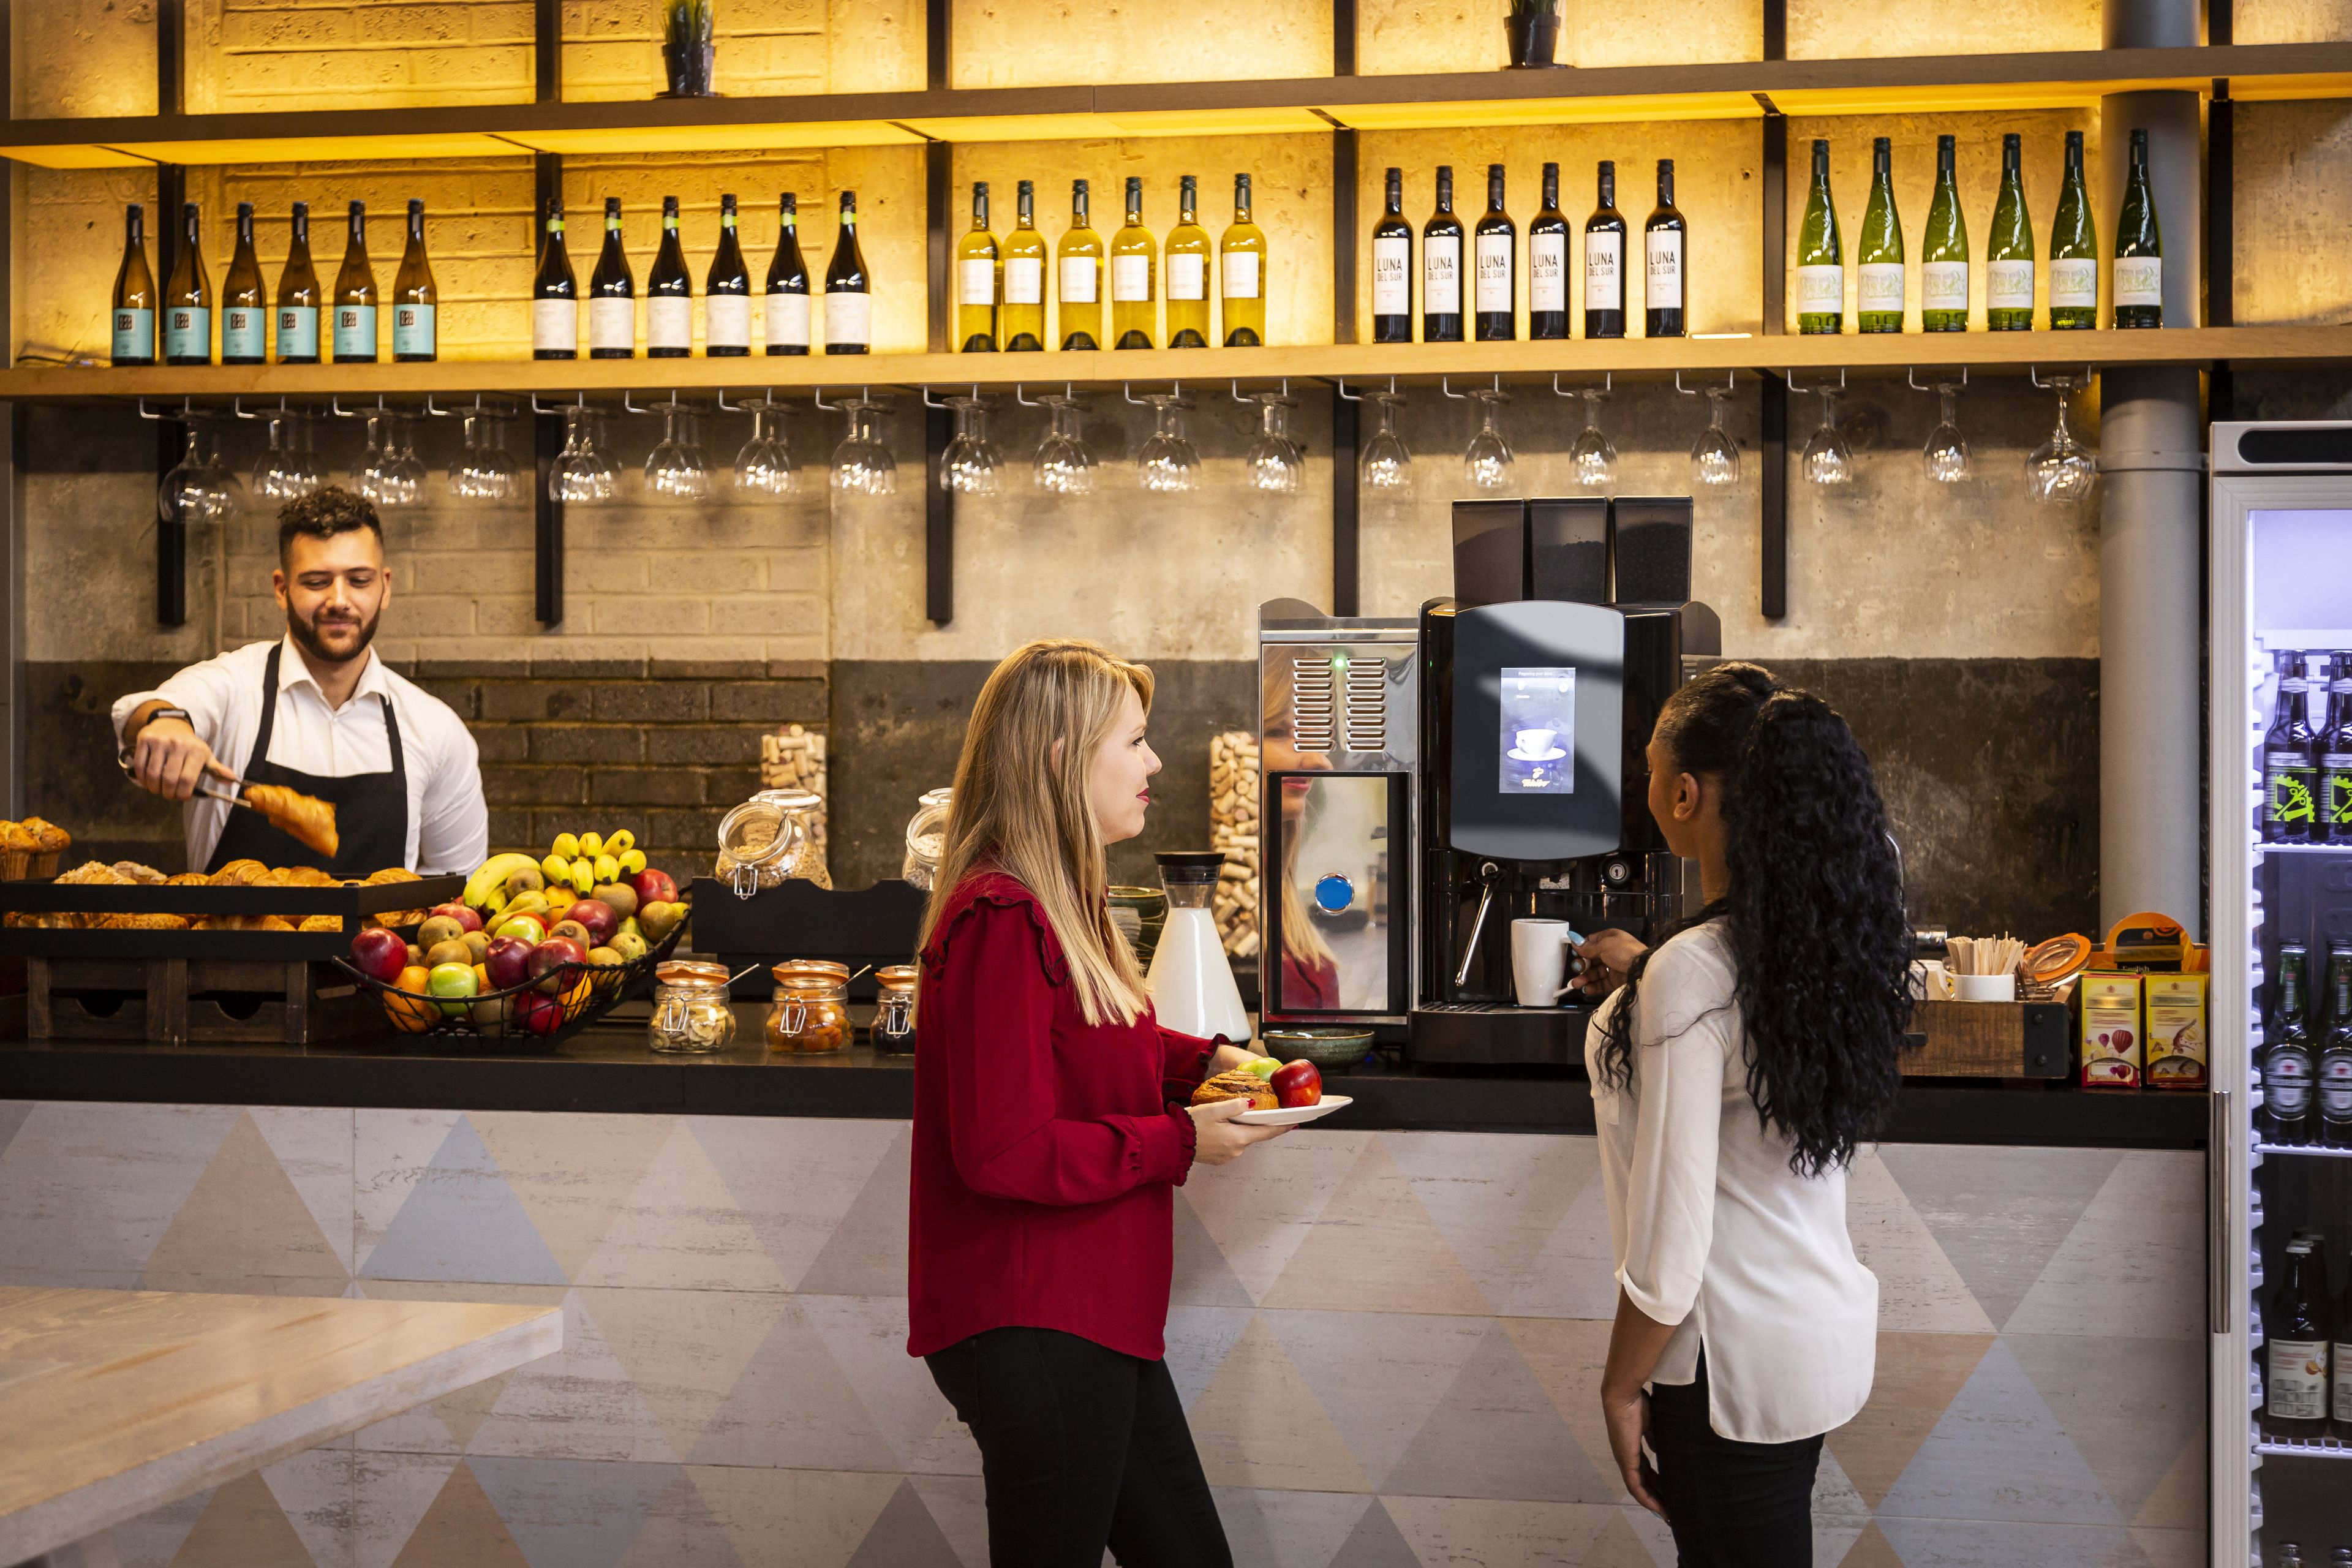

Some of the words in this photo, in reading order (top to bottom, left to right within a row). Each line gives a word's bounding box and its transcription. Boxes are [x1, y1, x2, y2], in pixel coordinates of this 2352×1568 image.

[1428, 256, 1453, 271] LUNA
[1480, 255, 1506, 268] LUNA
[1533, 254, 1558, 268] LUNA
[1589, 252, 1614, 266] LUNA
[1649, 251, 1675, 265] LUNA
[1378, 257, 1402, 271] LUNA
[1480, 270, 1490, 279] DEL
[1493, 269, 1506, 278] SUR
[1533, 269, 1543, 278] DEL
[1545, 268, 1558, 277] SUR
[1589, 267, 1599, 276] DEL
[1601, 266, 1614, 276] SUR
[1650, 266, 1660, 275] DEL
[1662, 265, 1676, 274] SUR
[1378, 273, 1387, 282] DEL
[1390, 272, 1403, 281] SUR
[1428, 271, 1438, 281] DEL
[1441, 271, 1453, 280] SUR
